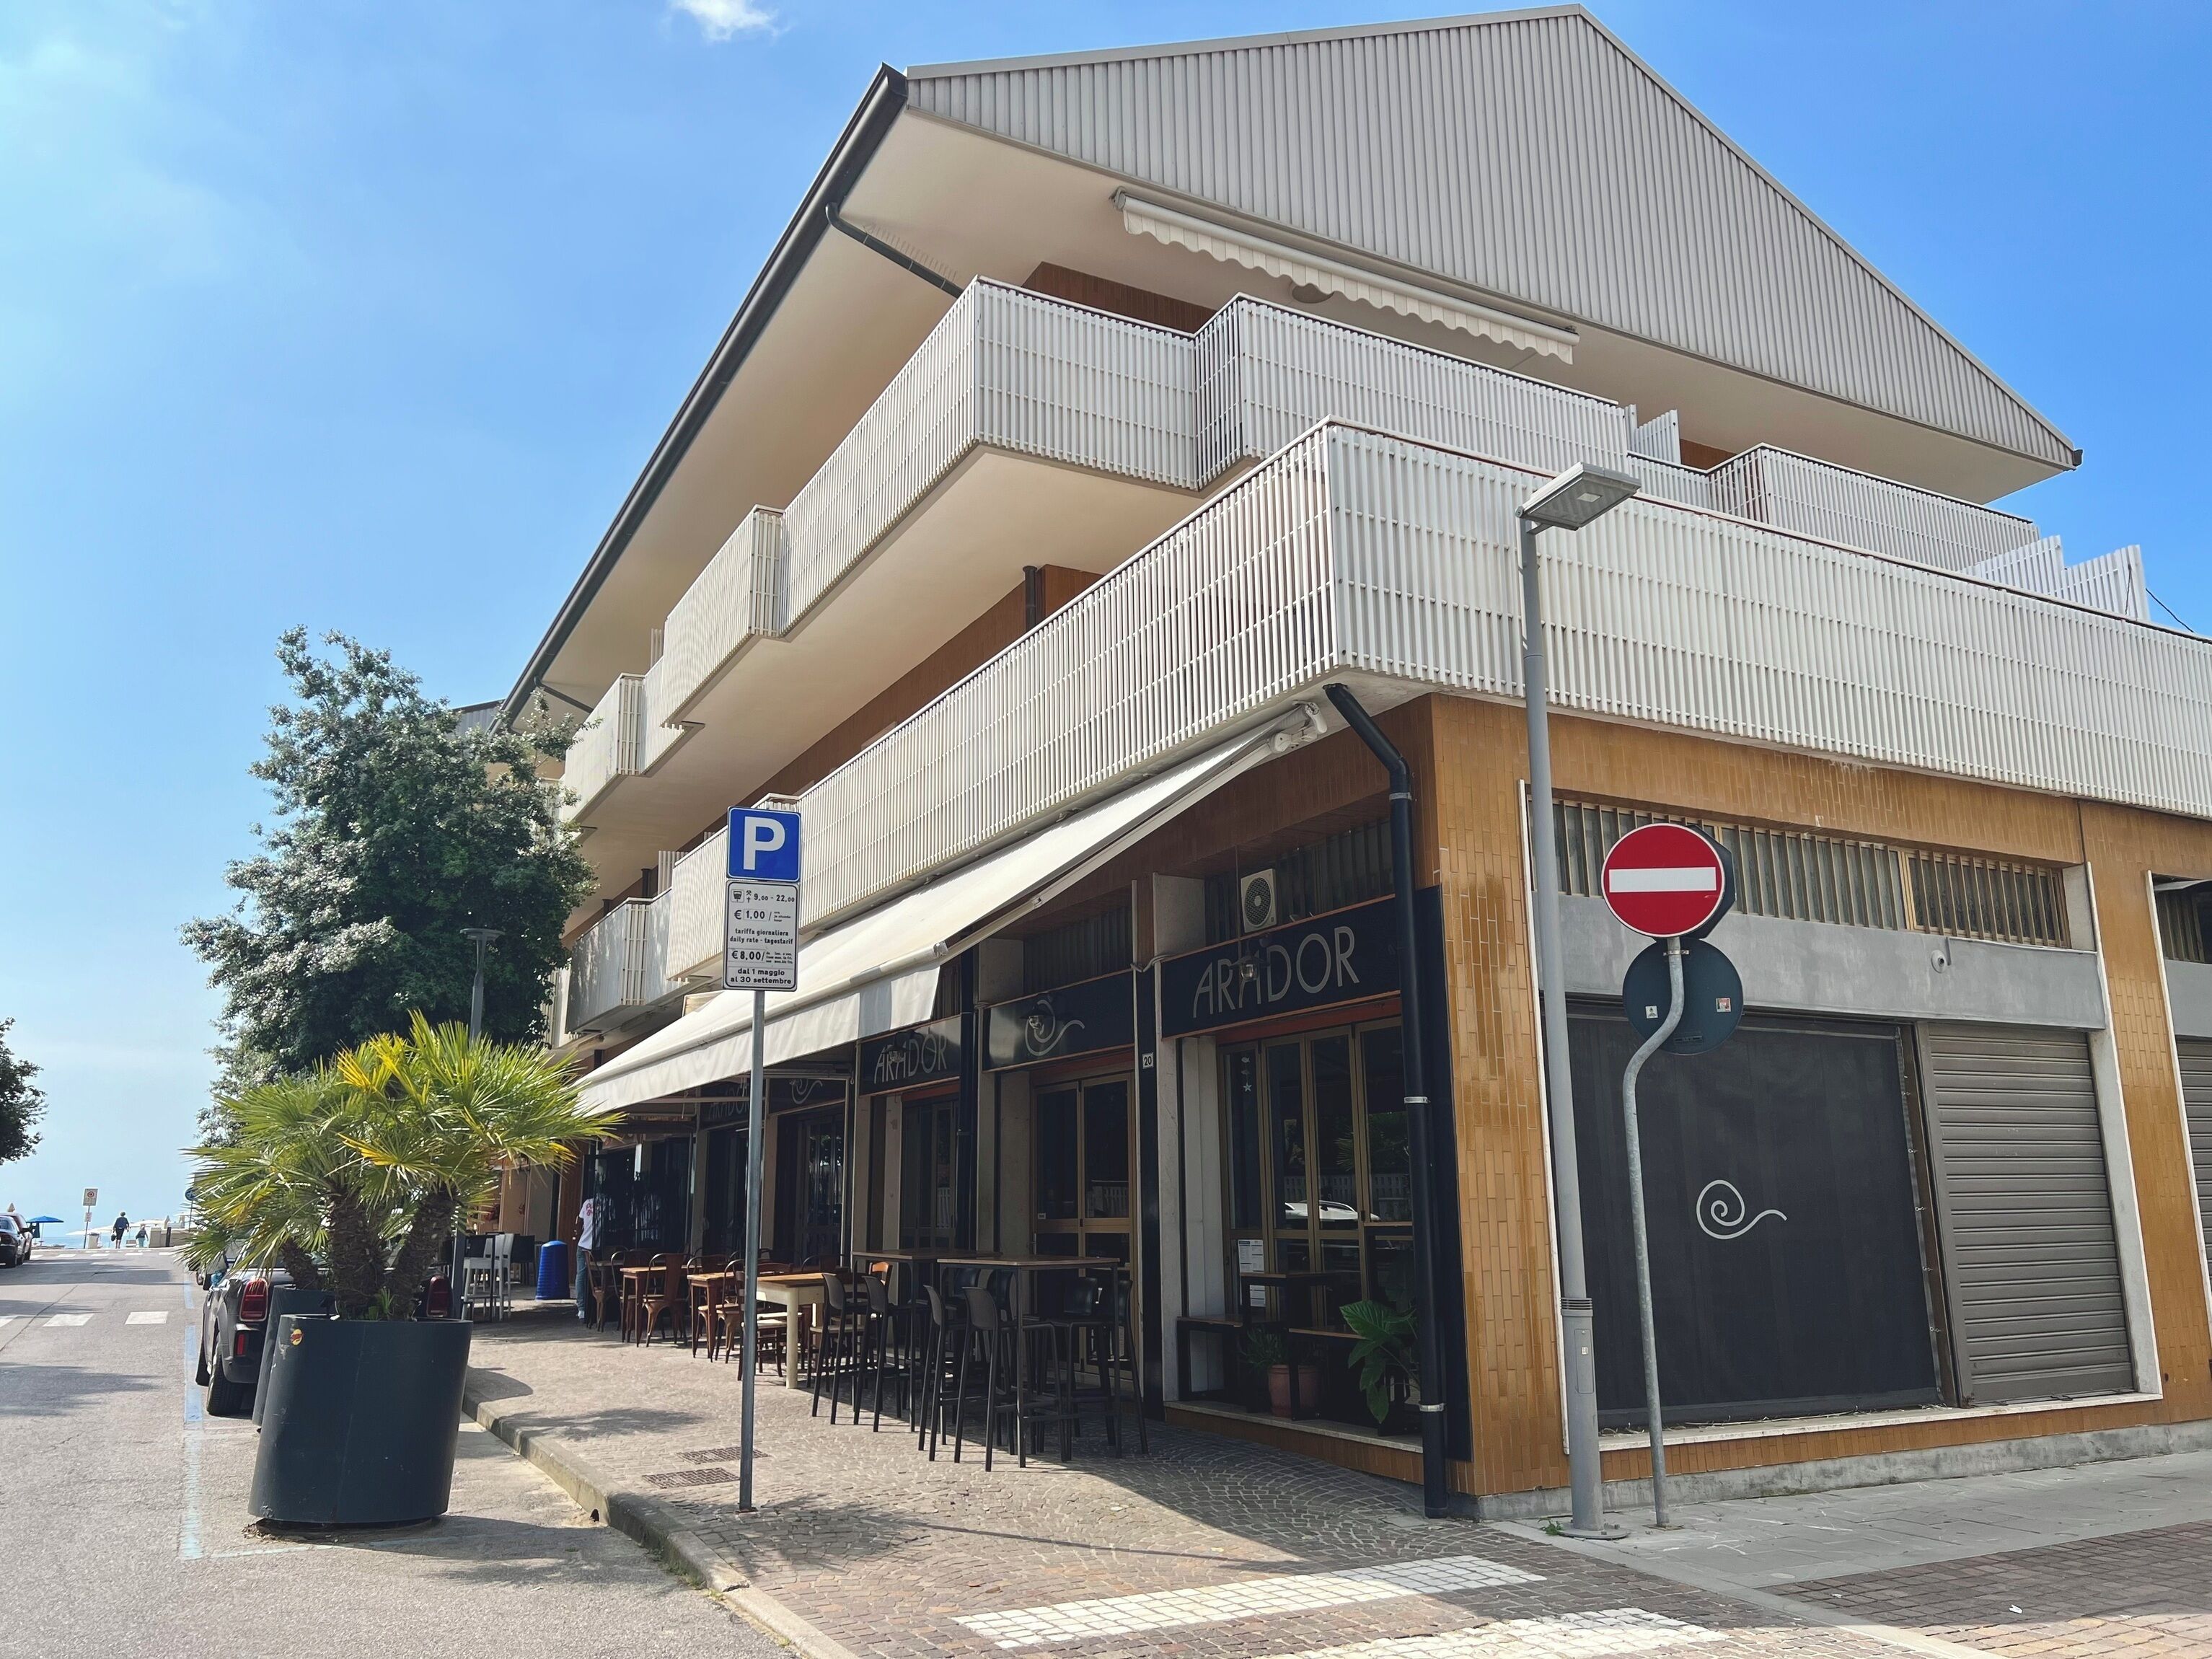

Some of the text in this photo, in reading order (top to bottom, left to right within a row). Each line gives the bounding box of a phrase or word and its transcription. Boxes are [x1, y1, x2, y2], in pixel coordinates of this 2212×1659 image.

[744, 816, 785, 871] P
[1192, 926, 1360, 1018] ARADOR
[1144, 1056, 1152, 1066] 20
